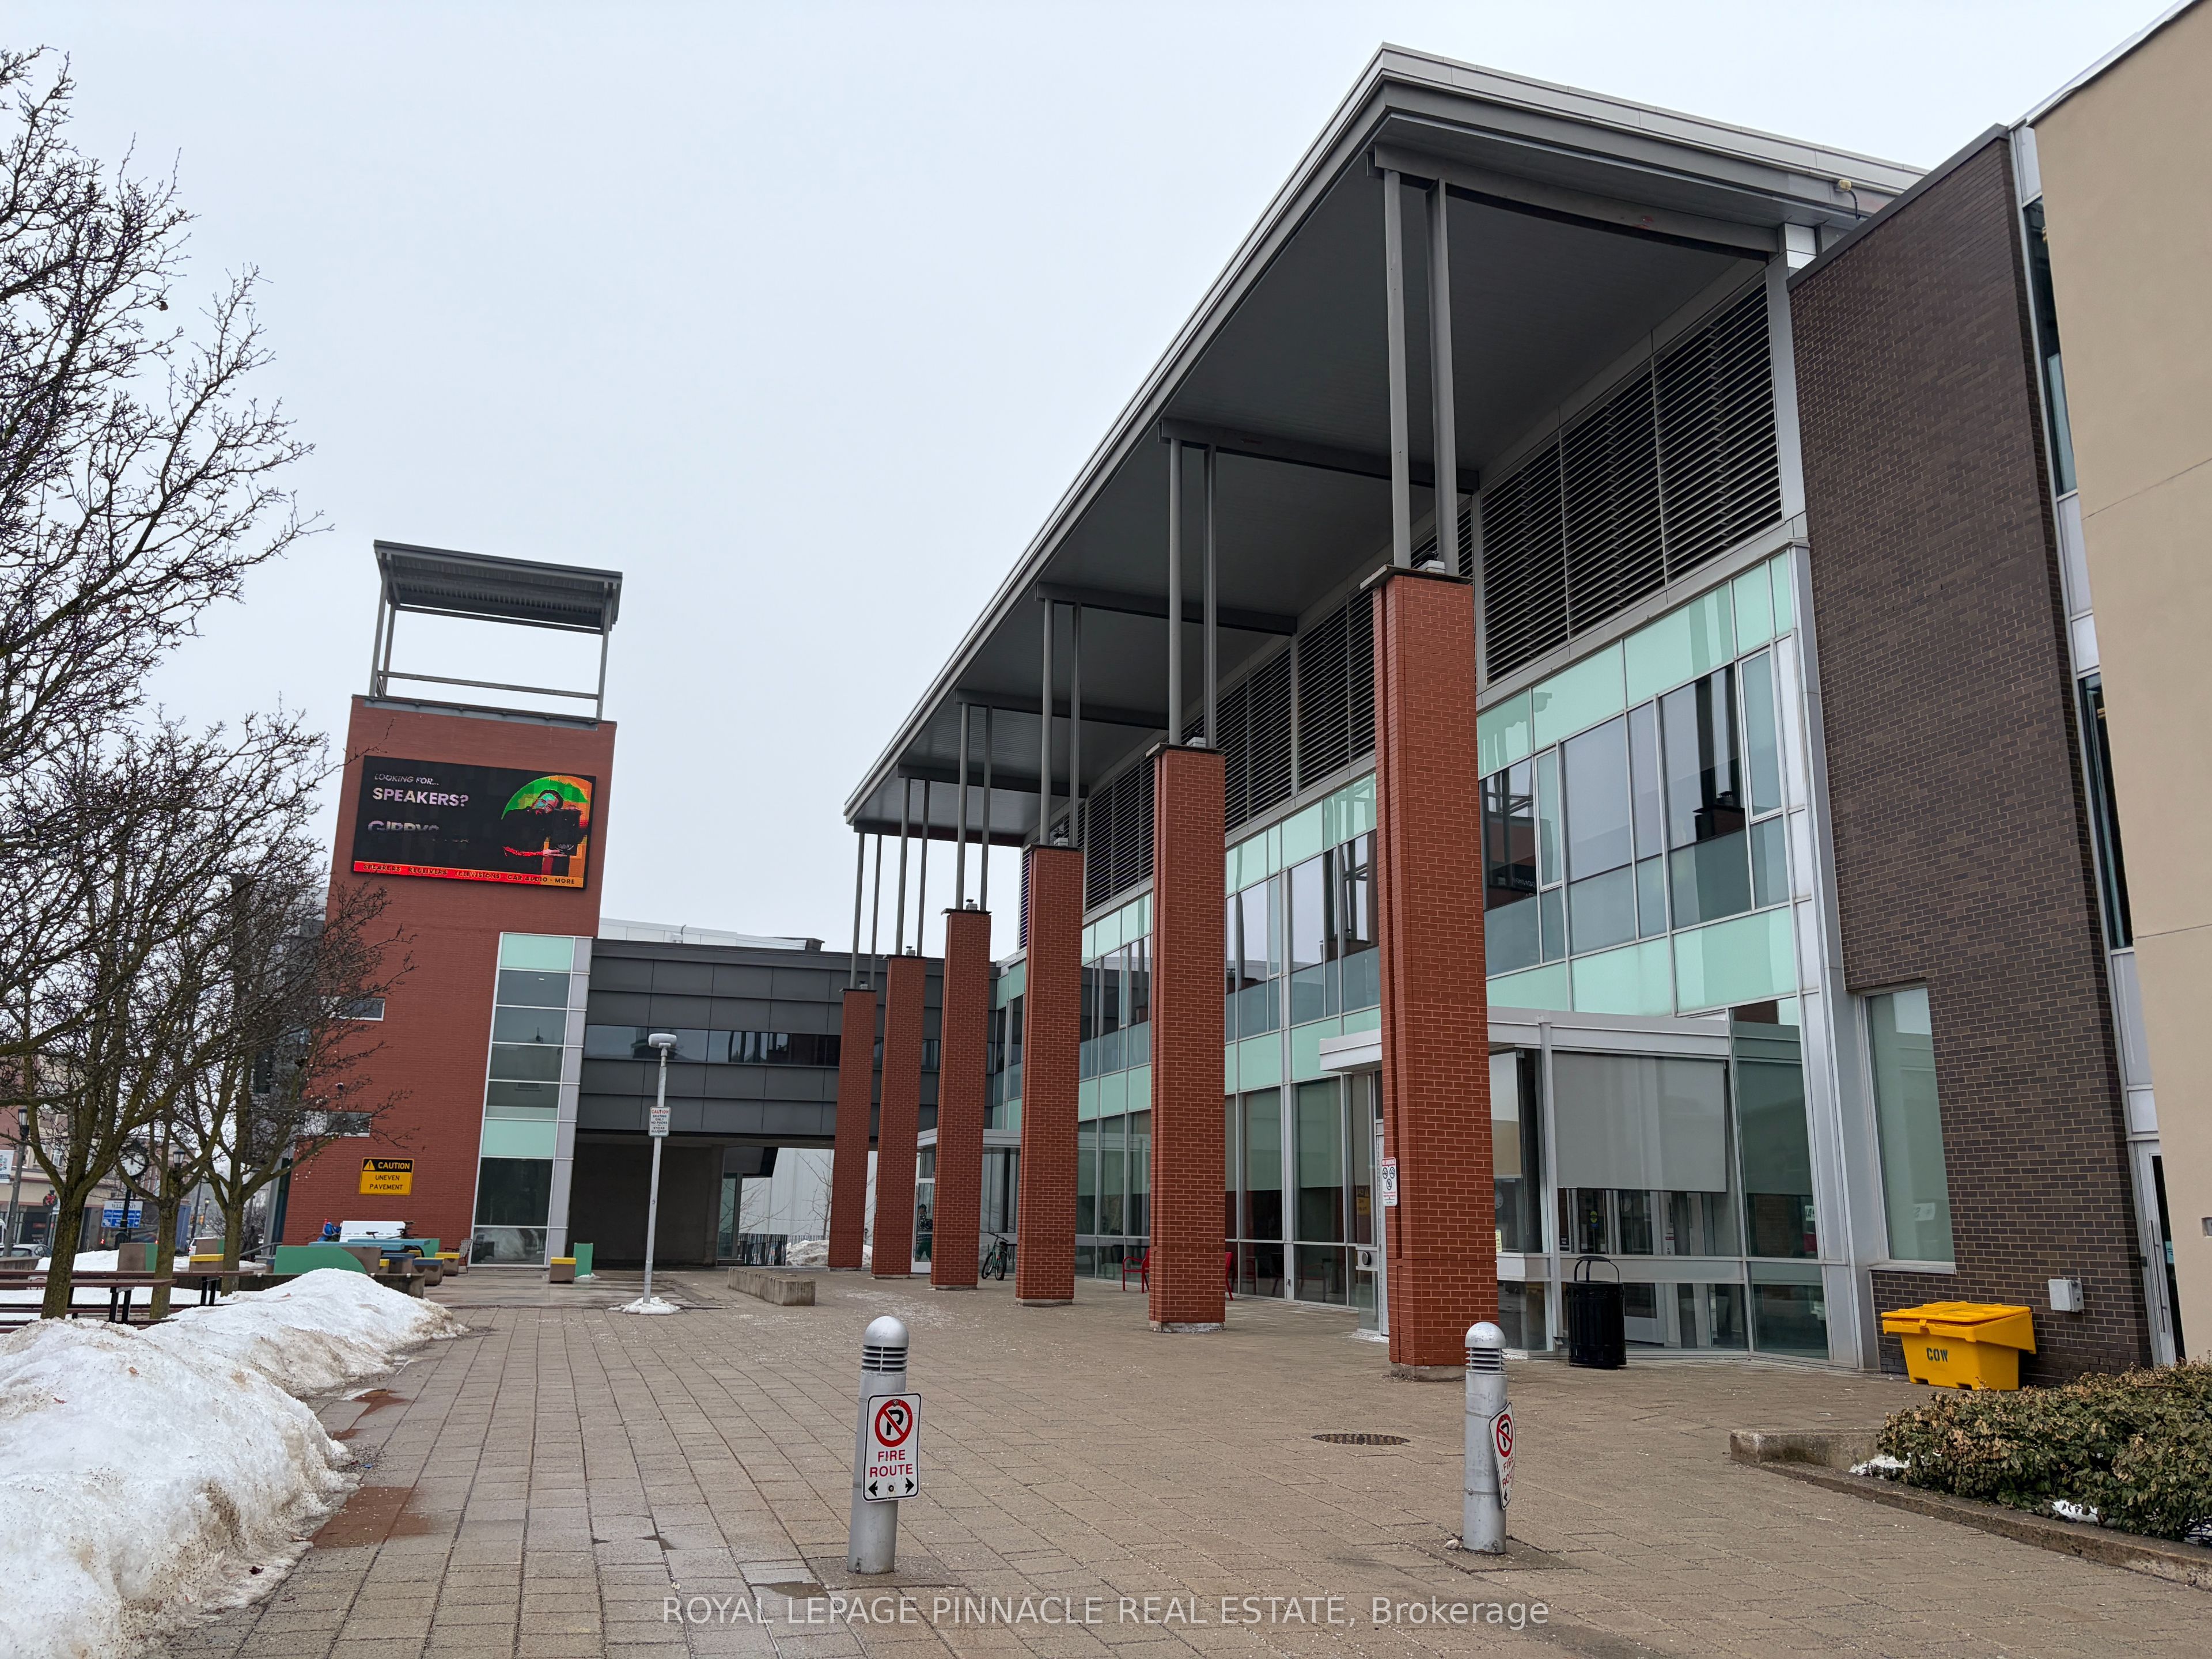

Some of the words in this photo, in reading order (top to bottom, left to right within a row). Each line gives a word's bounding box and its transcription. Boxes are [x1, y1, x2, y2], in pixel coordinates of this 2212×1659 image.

[374, 773, 414, 783] LOOKING
[373, 787, 469, 807] SPEAKERS?
[455, 870, 500, 879] TELEVISIONS
[1926, 1347, 1948, 1363] COW
[878, 1449, 906, 1463] FIRE
[1503, 1452, 1514, 1473] FIRE
[869, 1463, 913, 1478] ROUTE
[1502, 1466, 1514, 1488] ROU
